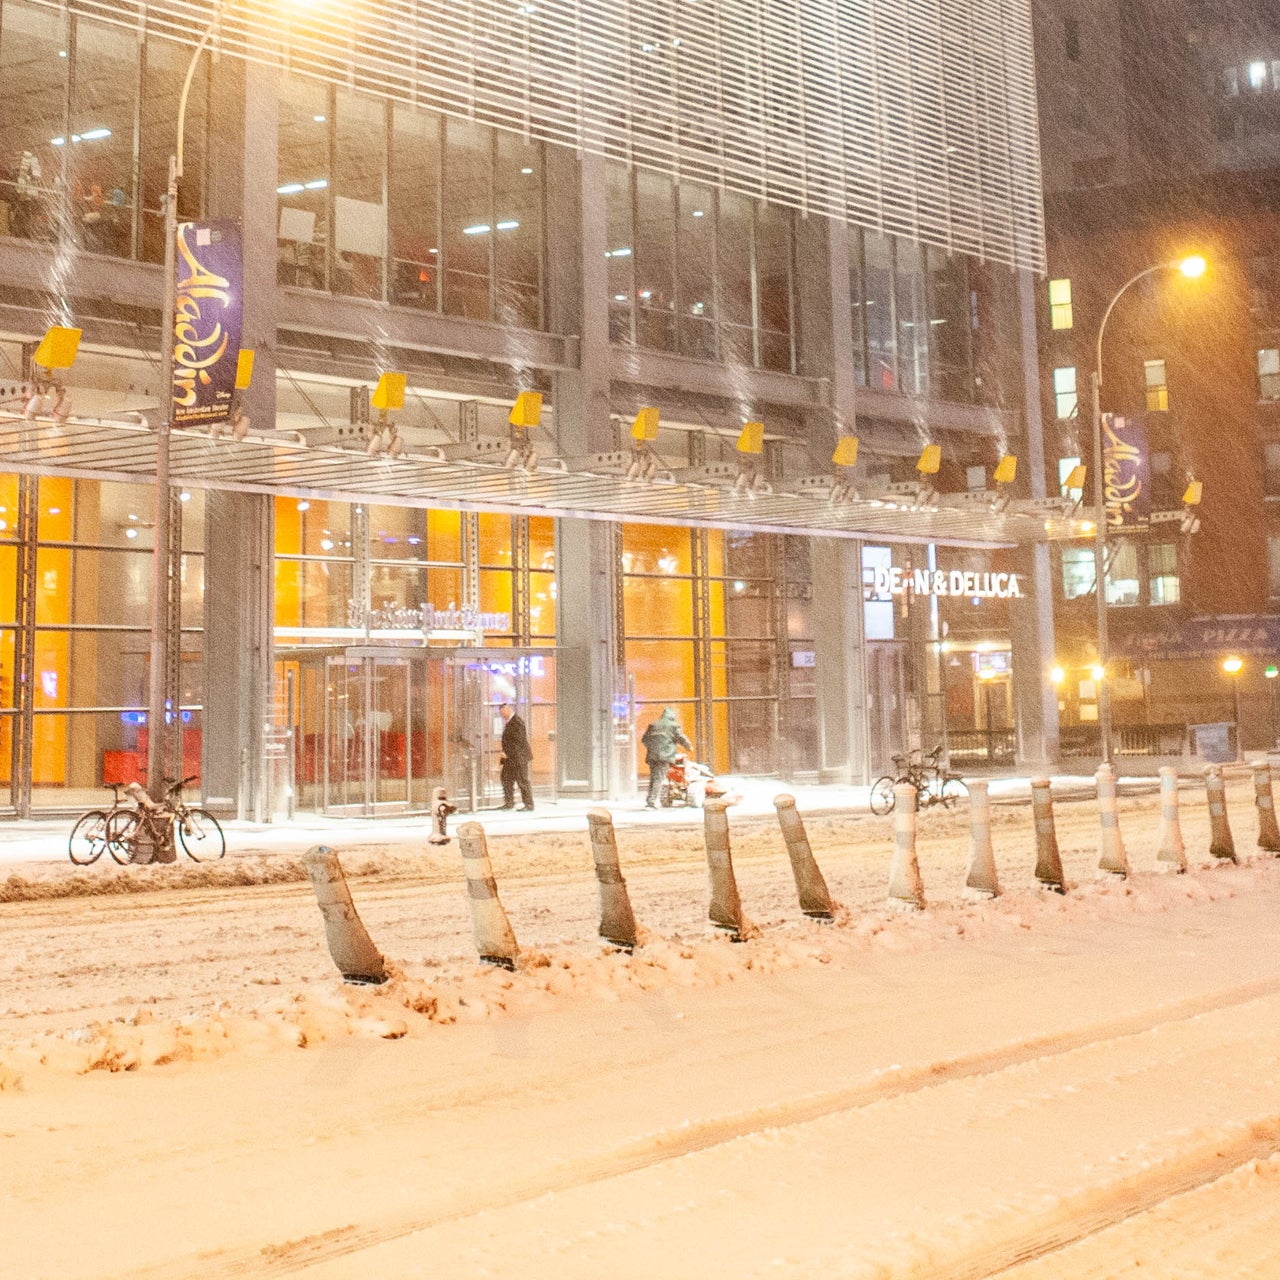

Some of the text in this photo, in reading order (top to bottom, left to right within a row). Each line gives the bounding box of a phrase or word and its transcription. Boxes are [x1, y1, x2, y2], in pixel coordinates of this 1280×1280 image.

[174, 222, 229, 406] Aladdin
[1101, 412, 1142, 526] Aladdin
[933, 570, 947, 596] &
[950, 570, 1021, 598] DELUCA
